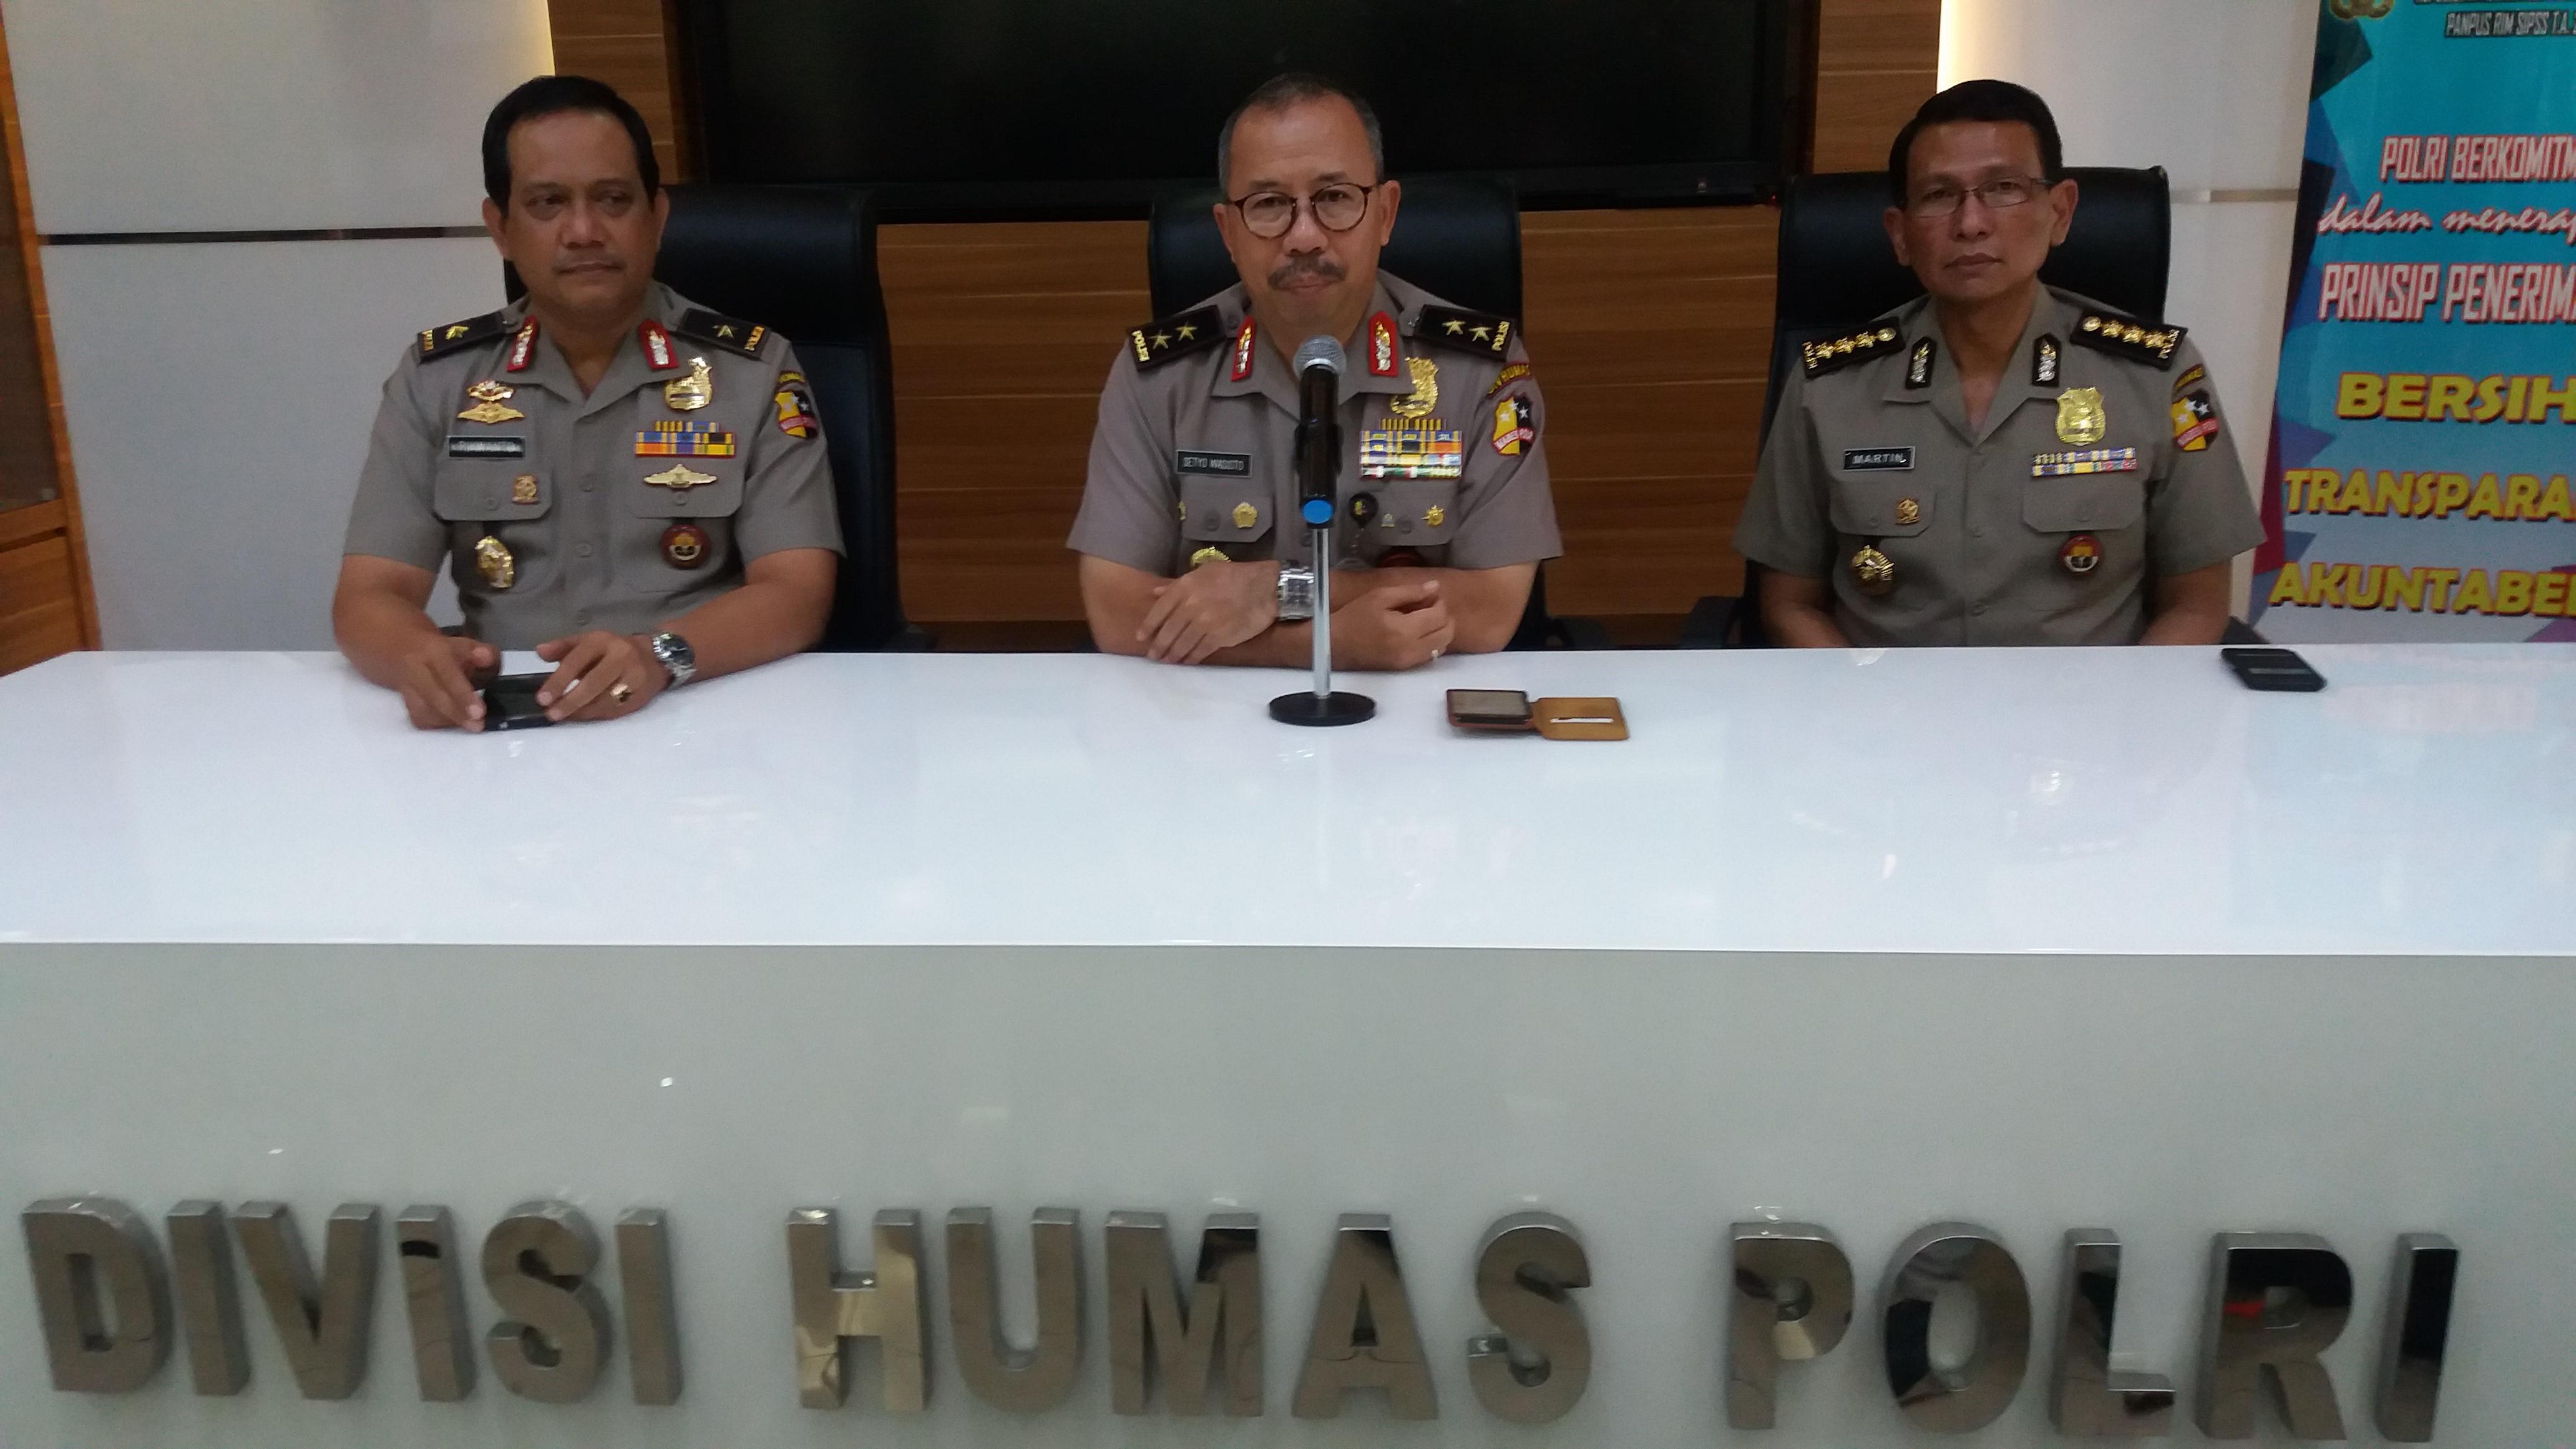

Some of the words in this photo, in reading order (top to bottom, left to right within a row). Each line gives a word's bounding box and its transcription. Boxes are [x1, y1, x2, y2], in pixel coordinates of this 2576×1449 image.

[2381, 136, 2448, 182] POLRI
[2317, 192, 2432, 235] dalam
[2318, 263, 2440, 322] PRINSIP
[2441, 263, 2576, 324] PENERIM
[2336, 371, 2576, 424] BERSIH
[1853, 454, 1905, 465] MARTIN
[2285, 468, 2576, 521] TRANSPARA
[22, 1196, 685, 1405] DIVISI
[787, 1207, 1593, 1425] HUMAS
[1728, 1221, 2459, 1443] POLRI
